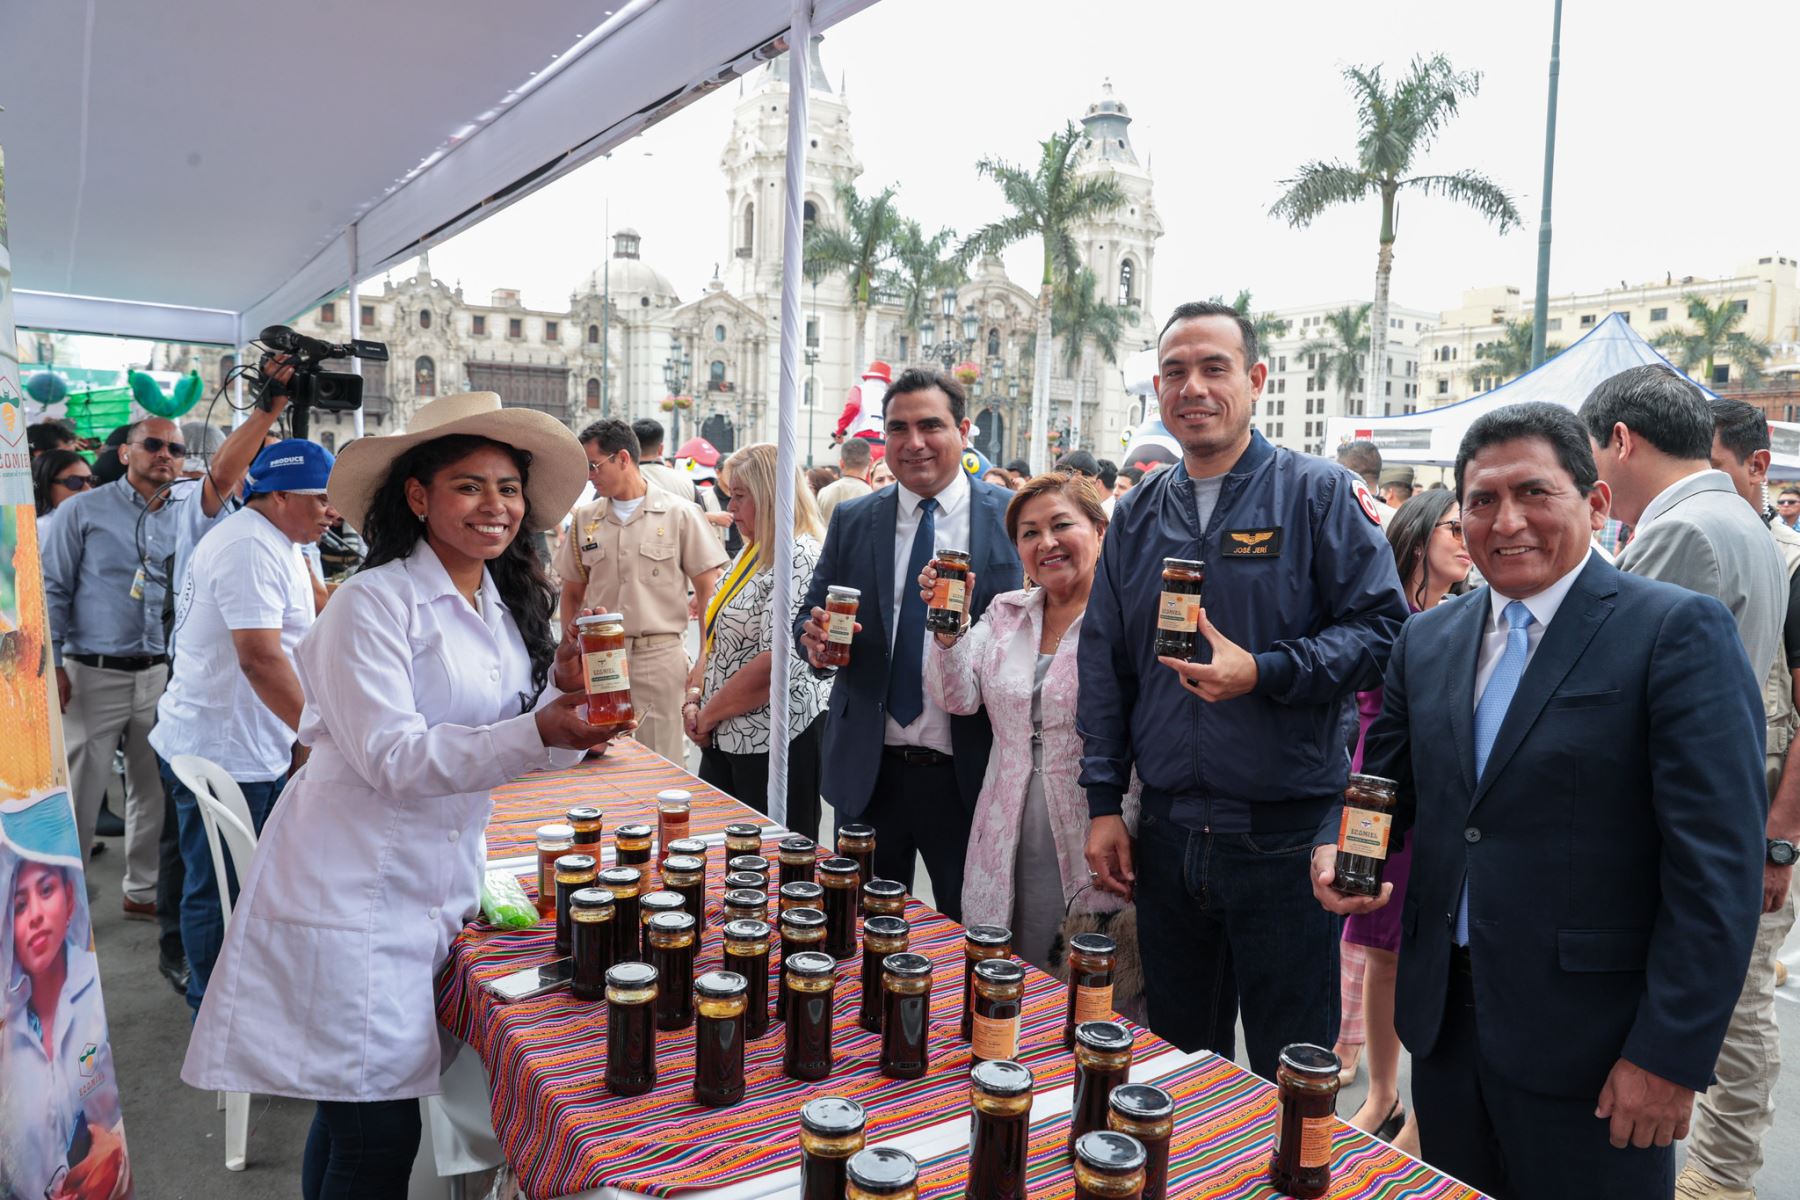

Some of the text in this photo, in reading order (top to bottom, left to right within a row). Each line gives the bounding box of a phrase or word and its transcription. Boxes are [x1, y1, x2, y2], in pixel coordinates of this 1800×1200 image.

[270, 456, 304, 466] PRODUCE
[1233, 545, 1268, 554] JOSÉ JERÍ
[1351, 828, 1378, 839] ECOMIEL
